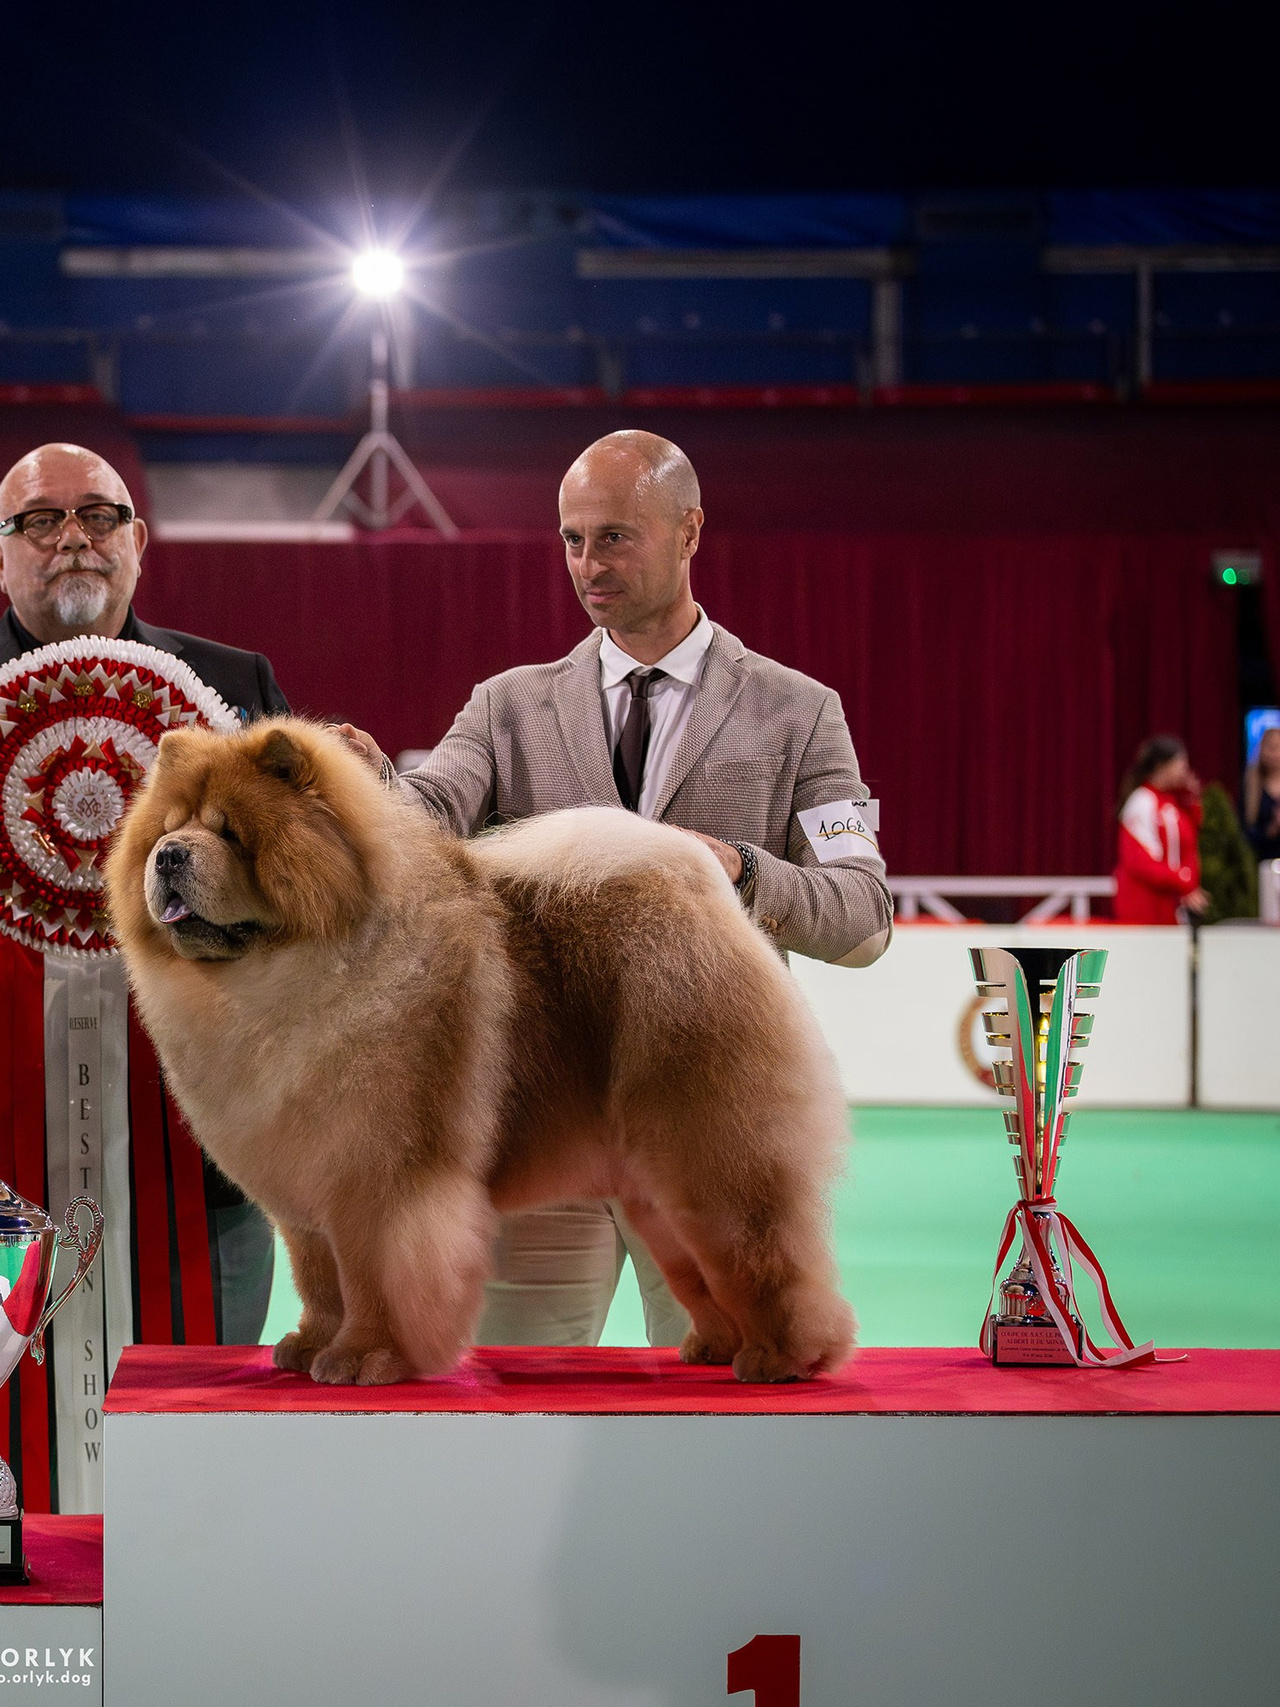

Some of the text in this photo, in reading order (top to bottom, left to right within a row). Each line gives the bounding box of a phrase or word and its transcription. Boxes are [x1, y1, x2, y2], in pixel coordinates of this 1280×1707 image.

[819, 817, 865, 842] 1068
[77, 1062, 93, 1190] BEST
[83, 1338, 102, 1464] SHOW
[727, 1634, 801, 1707] 1
